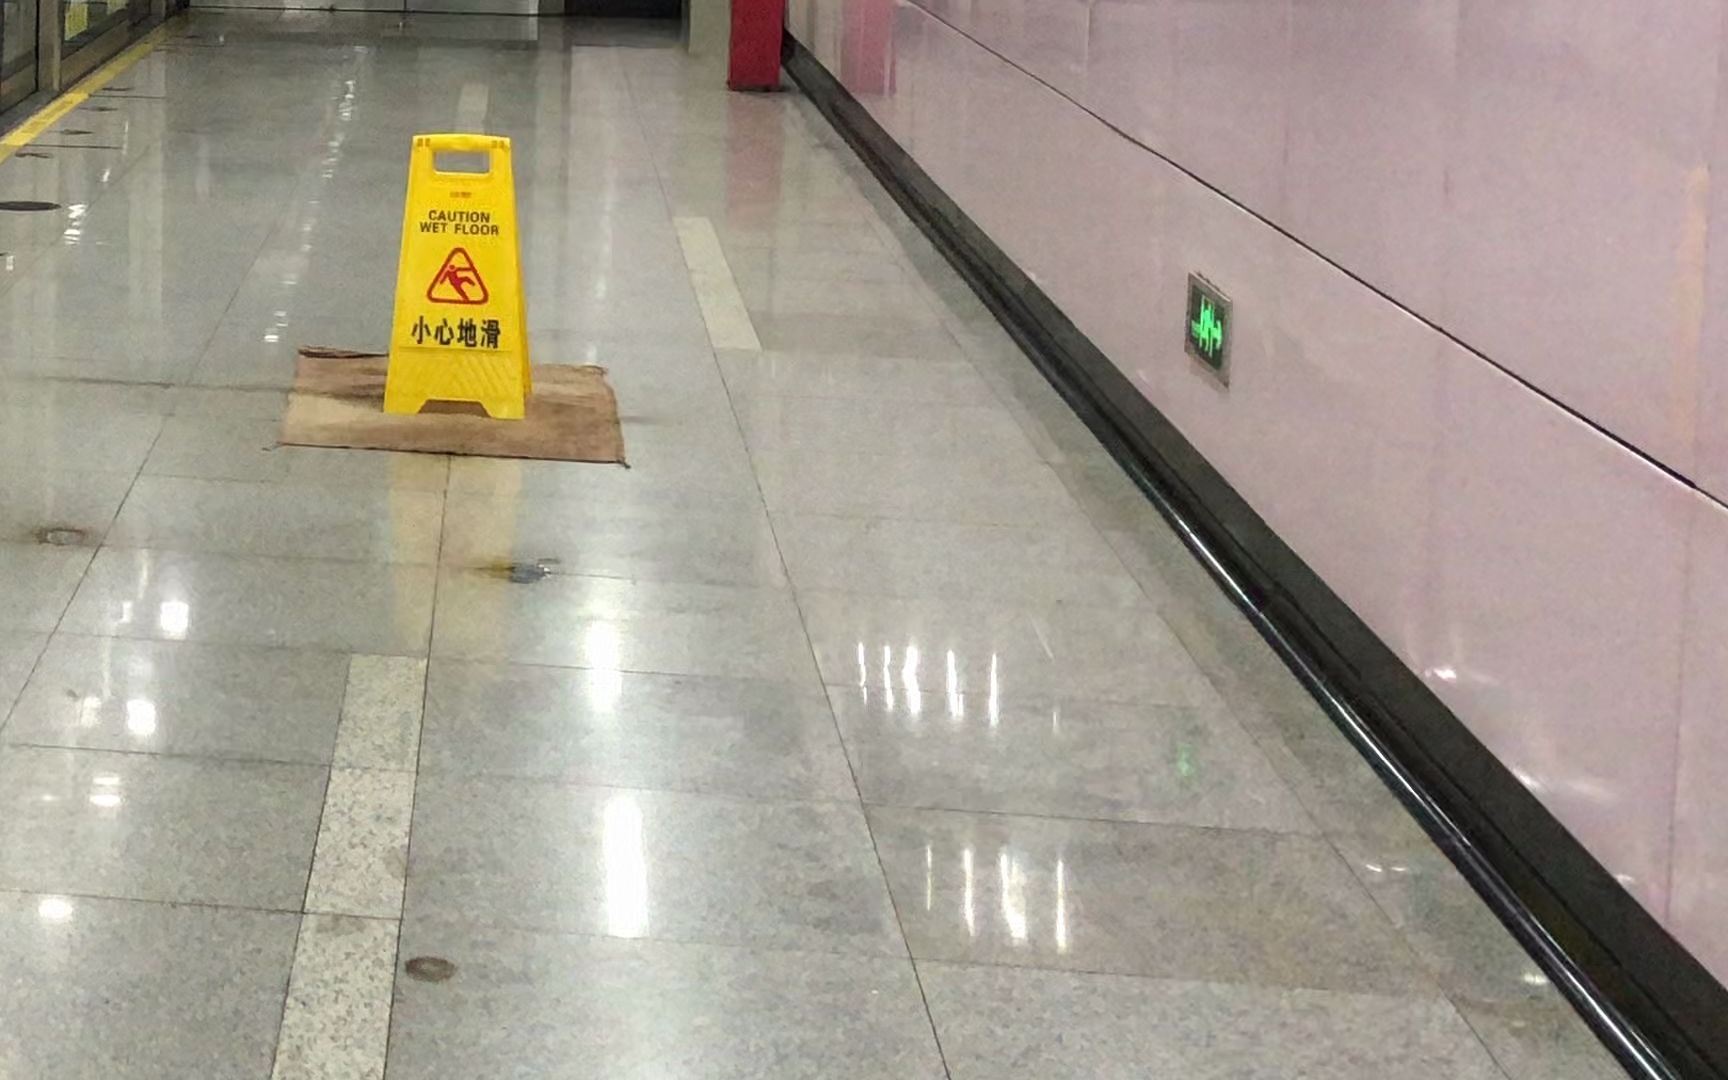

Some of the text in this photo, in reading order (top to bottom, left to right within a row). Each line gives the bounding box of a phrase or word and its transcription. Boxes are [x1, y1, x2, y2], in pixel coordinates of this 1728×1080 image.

[428, 210, 491, 224] CAUTION
[420, 222, 500, 236] WET FLOOR
[411, 315, 502, 349] 小心地滑
